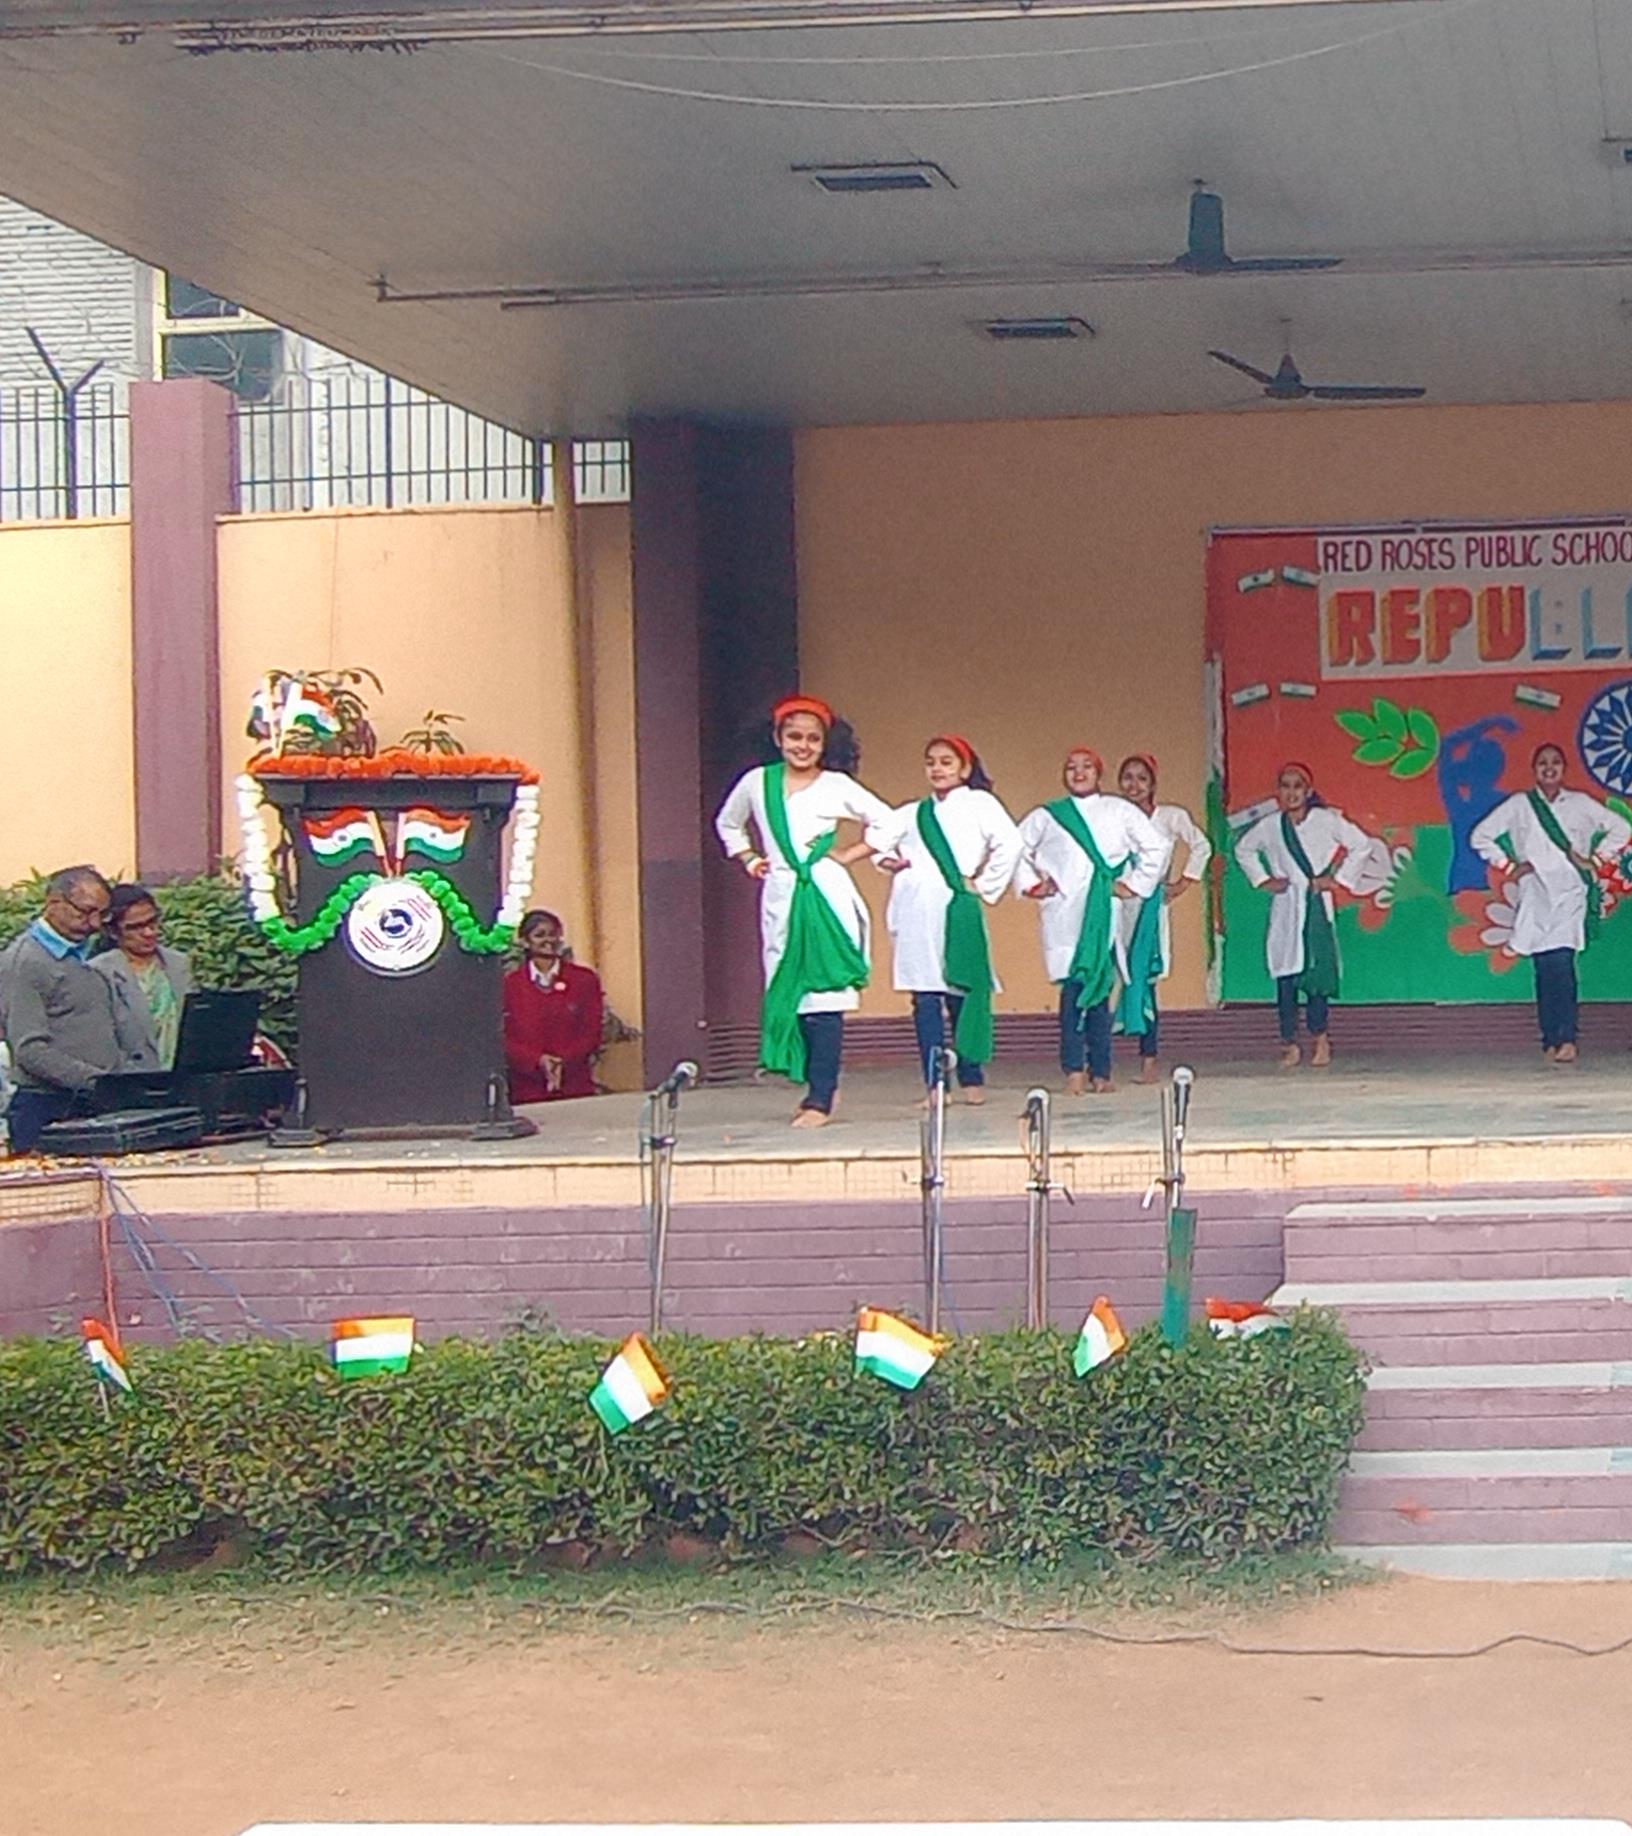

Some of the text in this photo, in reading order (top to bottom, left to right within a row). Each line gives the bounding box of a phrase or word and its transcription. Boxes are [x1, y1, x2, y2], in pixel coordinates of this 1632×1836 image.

[1323, 540, 1373, 573] RED
[1381, 537, 1456, 572] ROSES
[1465, 534, 1544, 569] PUBLIC
